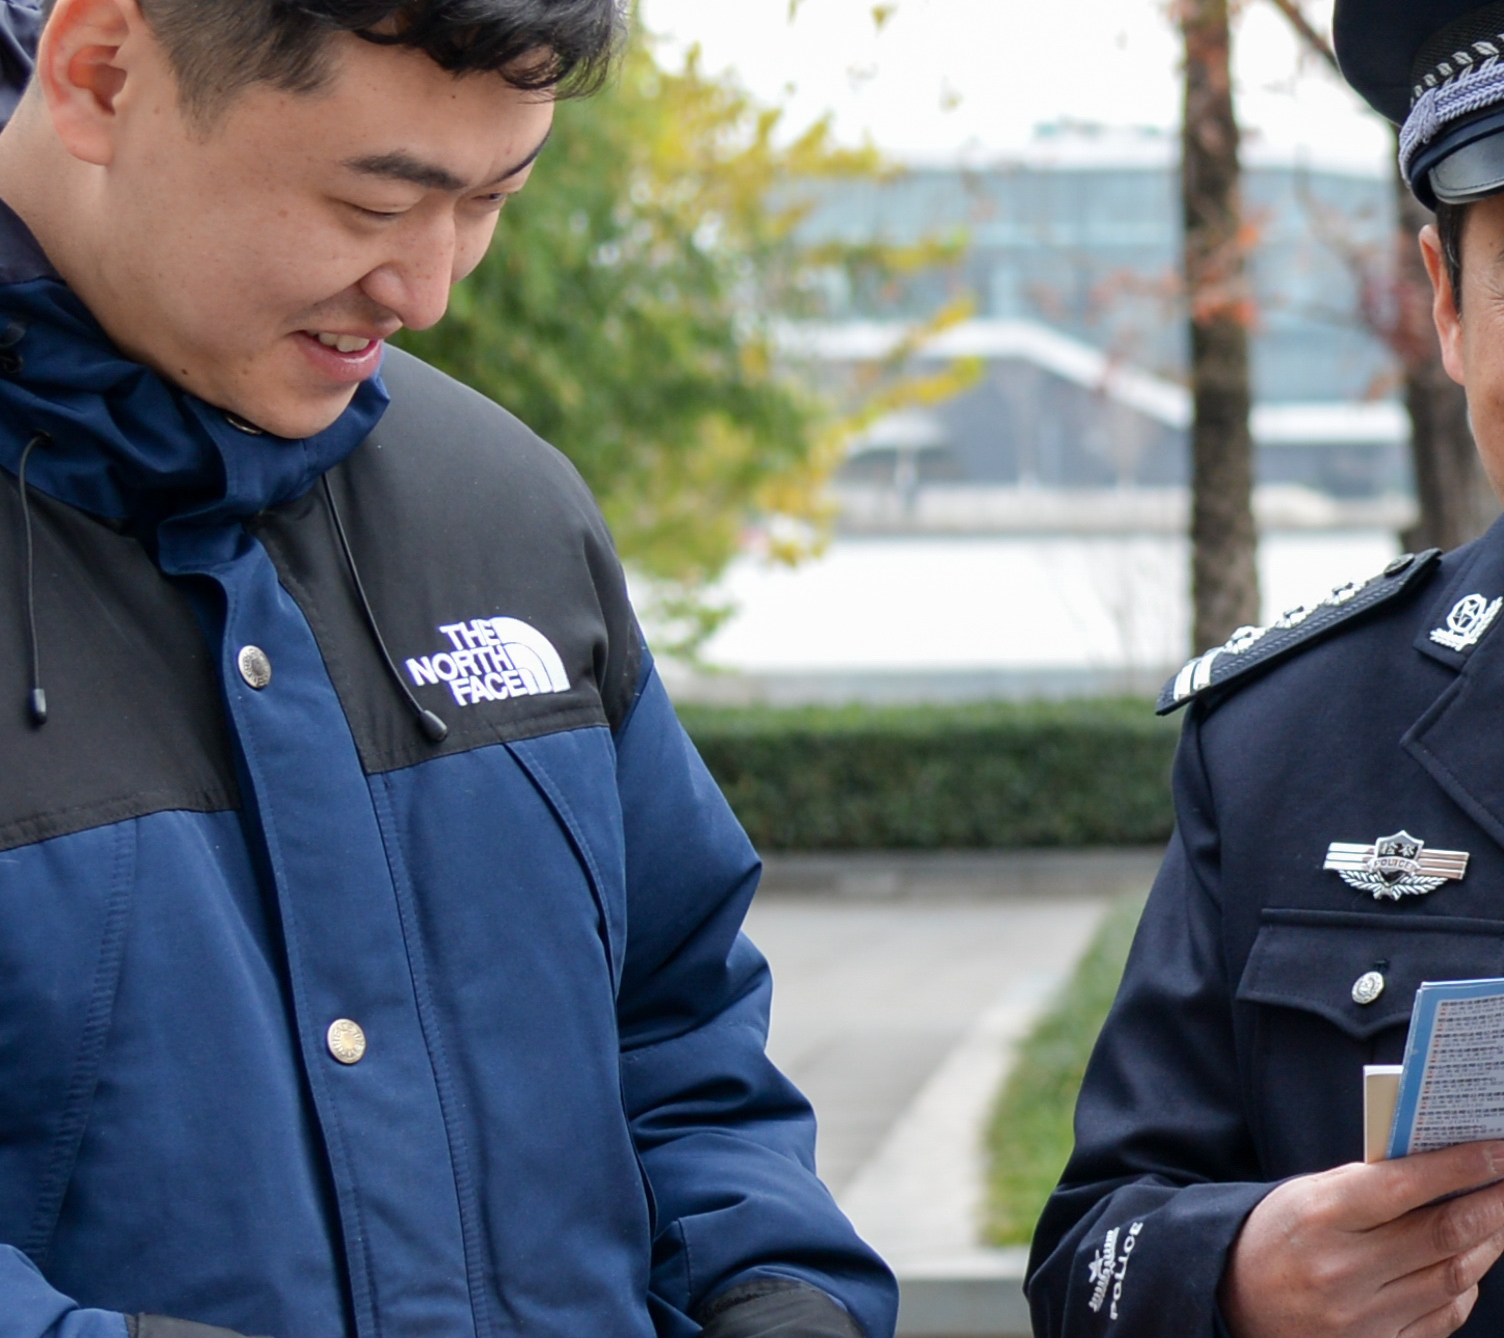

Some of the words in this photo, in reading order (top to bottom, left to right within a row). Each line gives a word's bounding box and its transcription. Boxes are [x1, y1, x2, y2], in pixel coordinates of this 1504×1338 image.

[438, 619, 502, 650] THE
[405, 644, 514, 686] NORTH
[449, 669, 528, 706] FACE
[1373, 857, 1412, 870] POLICE
[1109, 1221, 1144, 1320] POLICE
